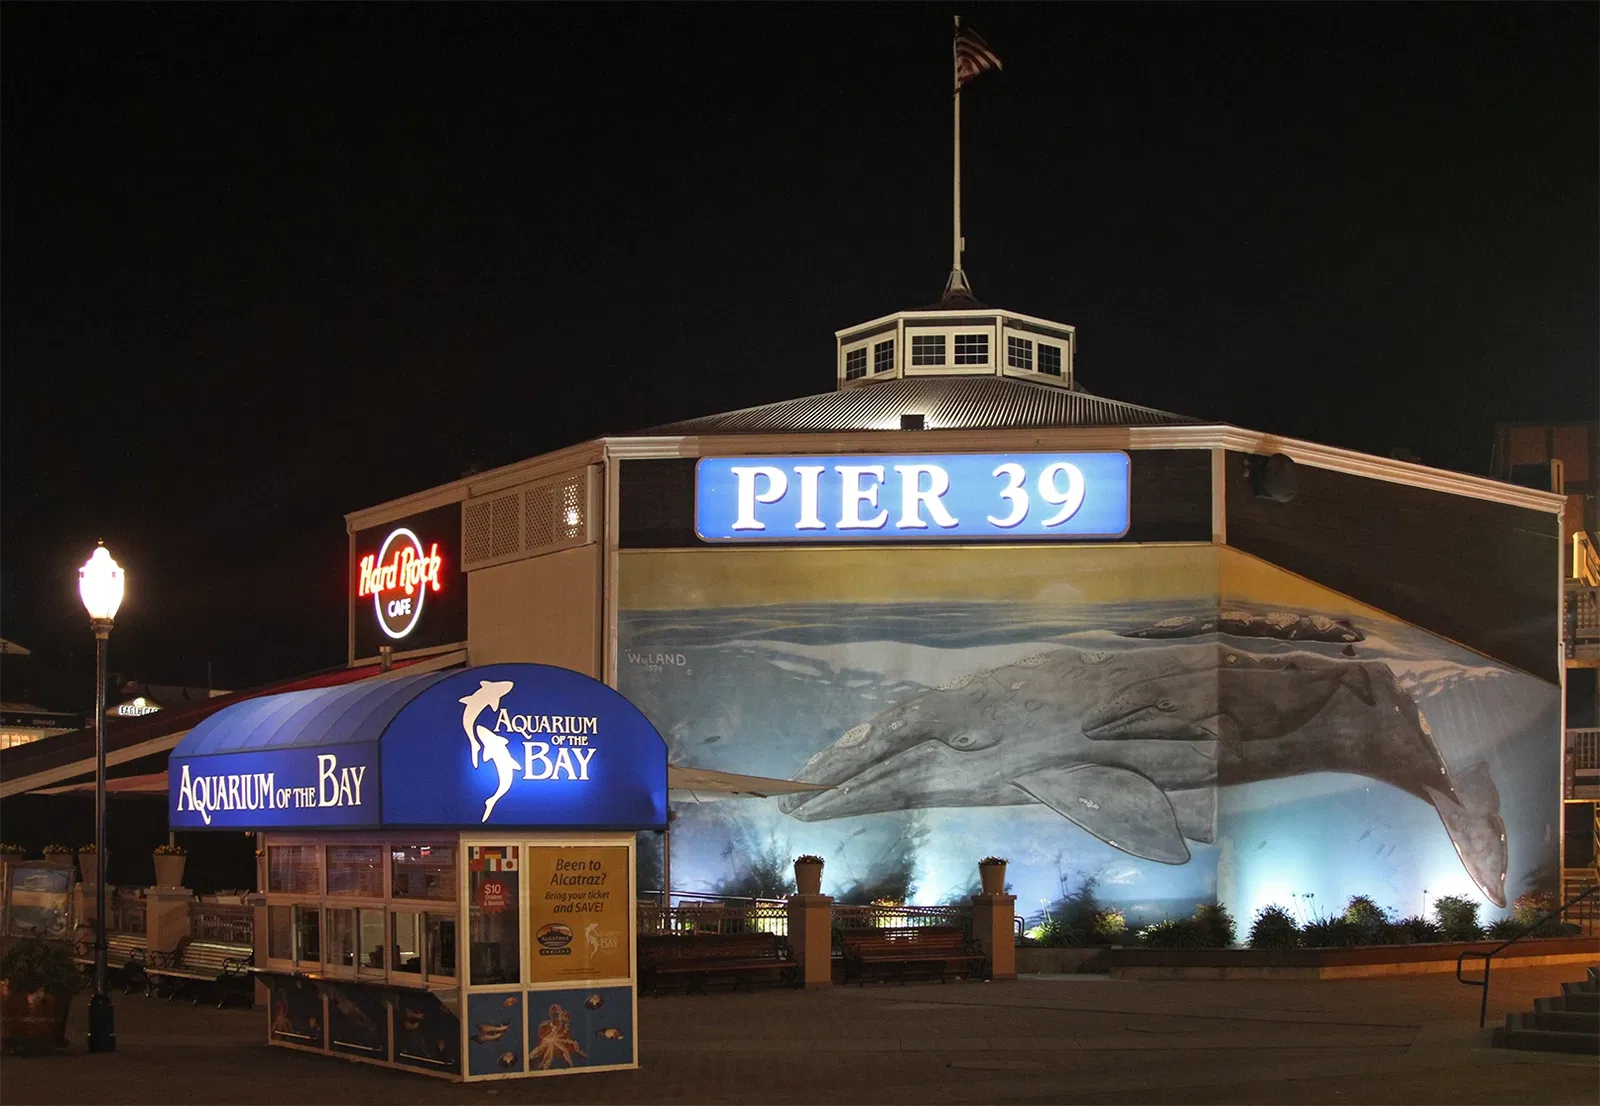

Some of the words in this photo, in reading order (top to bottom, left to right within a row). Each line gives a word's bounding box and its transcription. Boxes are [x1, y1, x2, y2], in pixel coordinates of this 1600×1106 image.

[731, 464, 959, 531] PIER
[987, 461, 1086, 528] 39
[359, 551, 400, 596] Hard
[400, 543, 441, 595] Rock
[388, 598, 412, 617] CAFE
[119, 705, 141, 716] EAGLE
[494, 708, 598, 740] AQUARIUM
[551, 736, 566, 746] OF
[568, 736, 588, 746] THE
[522, 741, 597, 780] BAY
[177, 765, 275, 825] AQUARIUM
[276, 789, 291, 809] OF
[293, 787, 316, 807] THE
[317, 754, 366, 807] BAY
[556, 859, 585, 871] Been
[589, 860, 601, 871] to
[550, 873, 606, 886] Alcatraz?
[484, 884, 501, 895] $10
[545, 891, 566, 901] Bring
[568, 893, 586, 901] your
[588, 890, 609, 899] ticket
[553, 903, 573, 913] and
[575, 902, 603, 912] SAVE!
